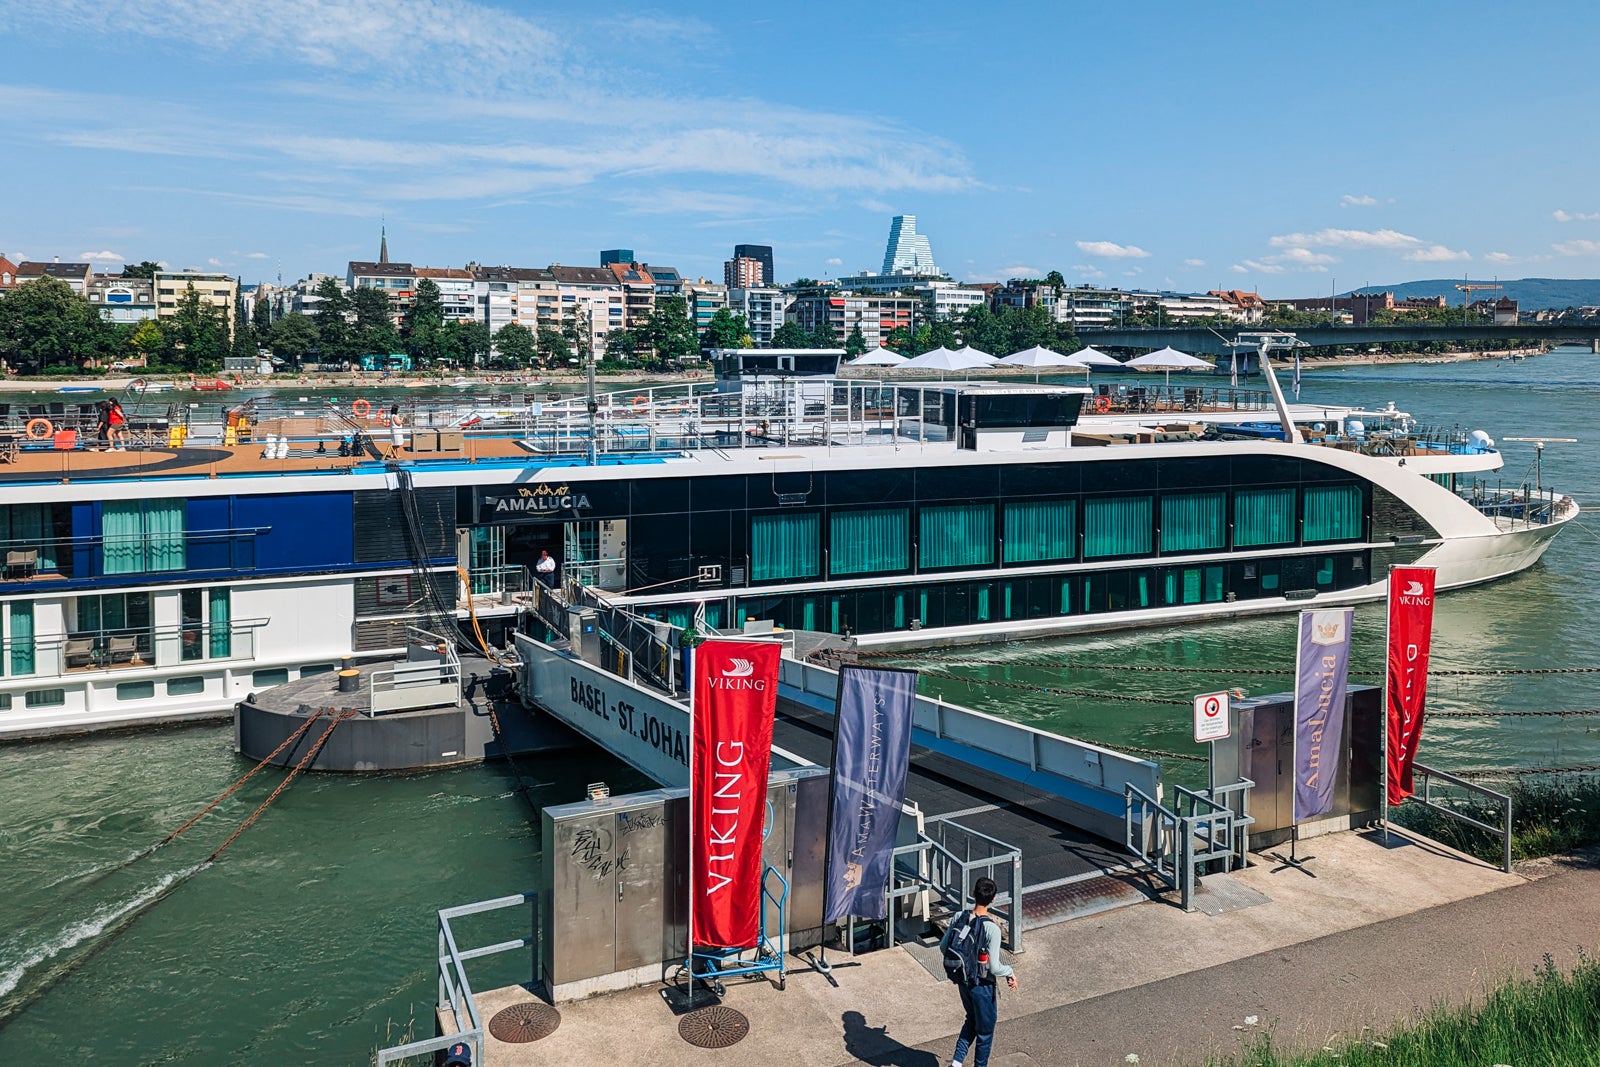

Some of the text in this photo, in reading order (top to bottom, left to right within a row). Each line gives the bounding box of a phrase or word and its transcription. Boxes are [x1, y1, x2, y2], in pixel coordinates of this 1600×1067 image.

[496, 495, 592, 511] AMALUCIA
[1399, 596, 1431, 606] VKING
[708, 677, 765, 691] VIKING
[1305, 654, 1336, 789] AmaLucia
[640, 712, 690, 768] JOHA
[707, 740, 744, 896] VIKING
